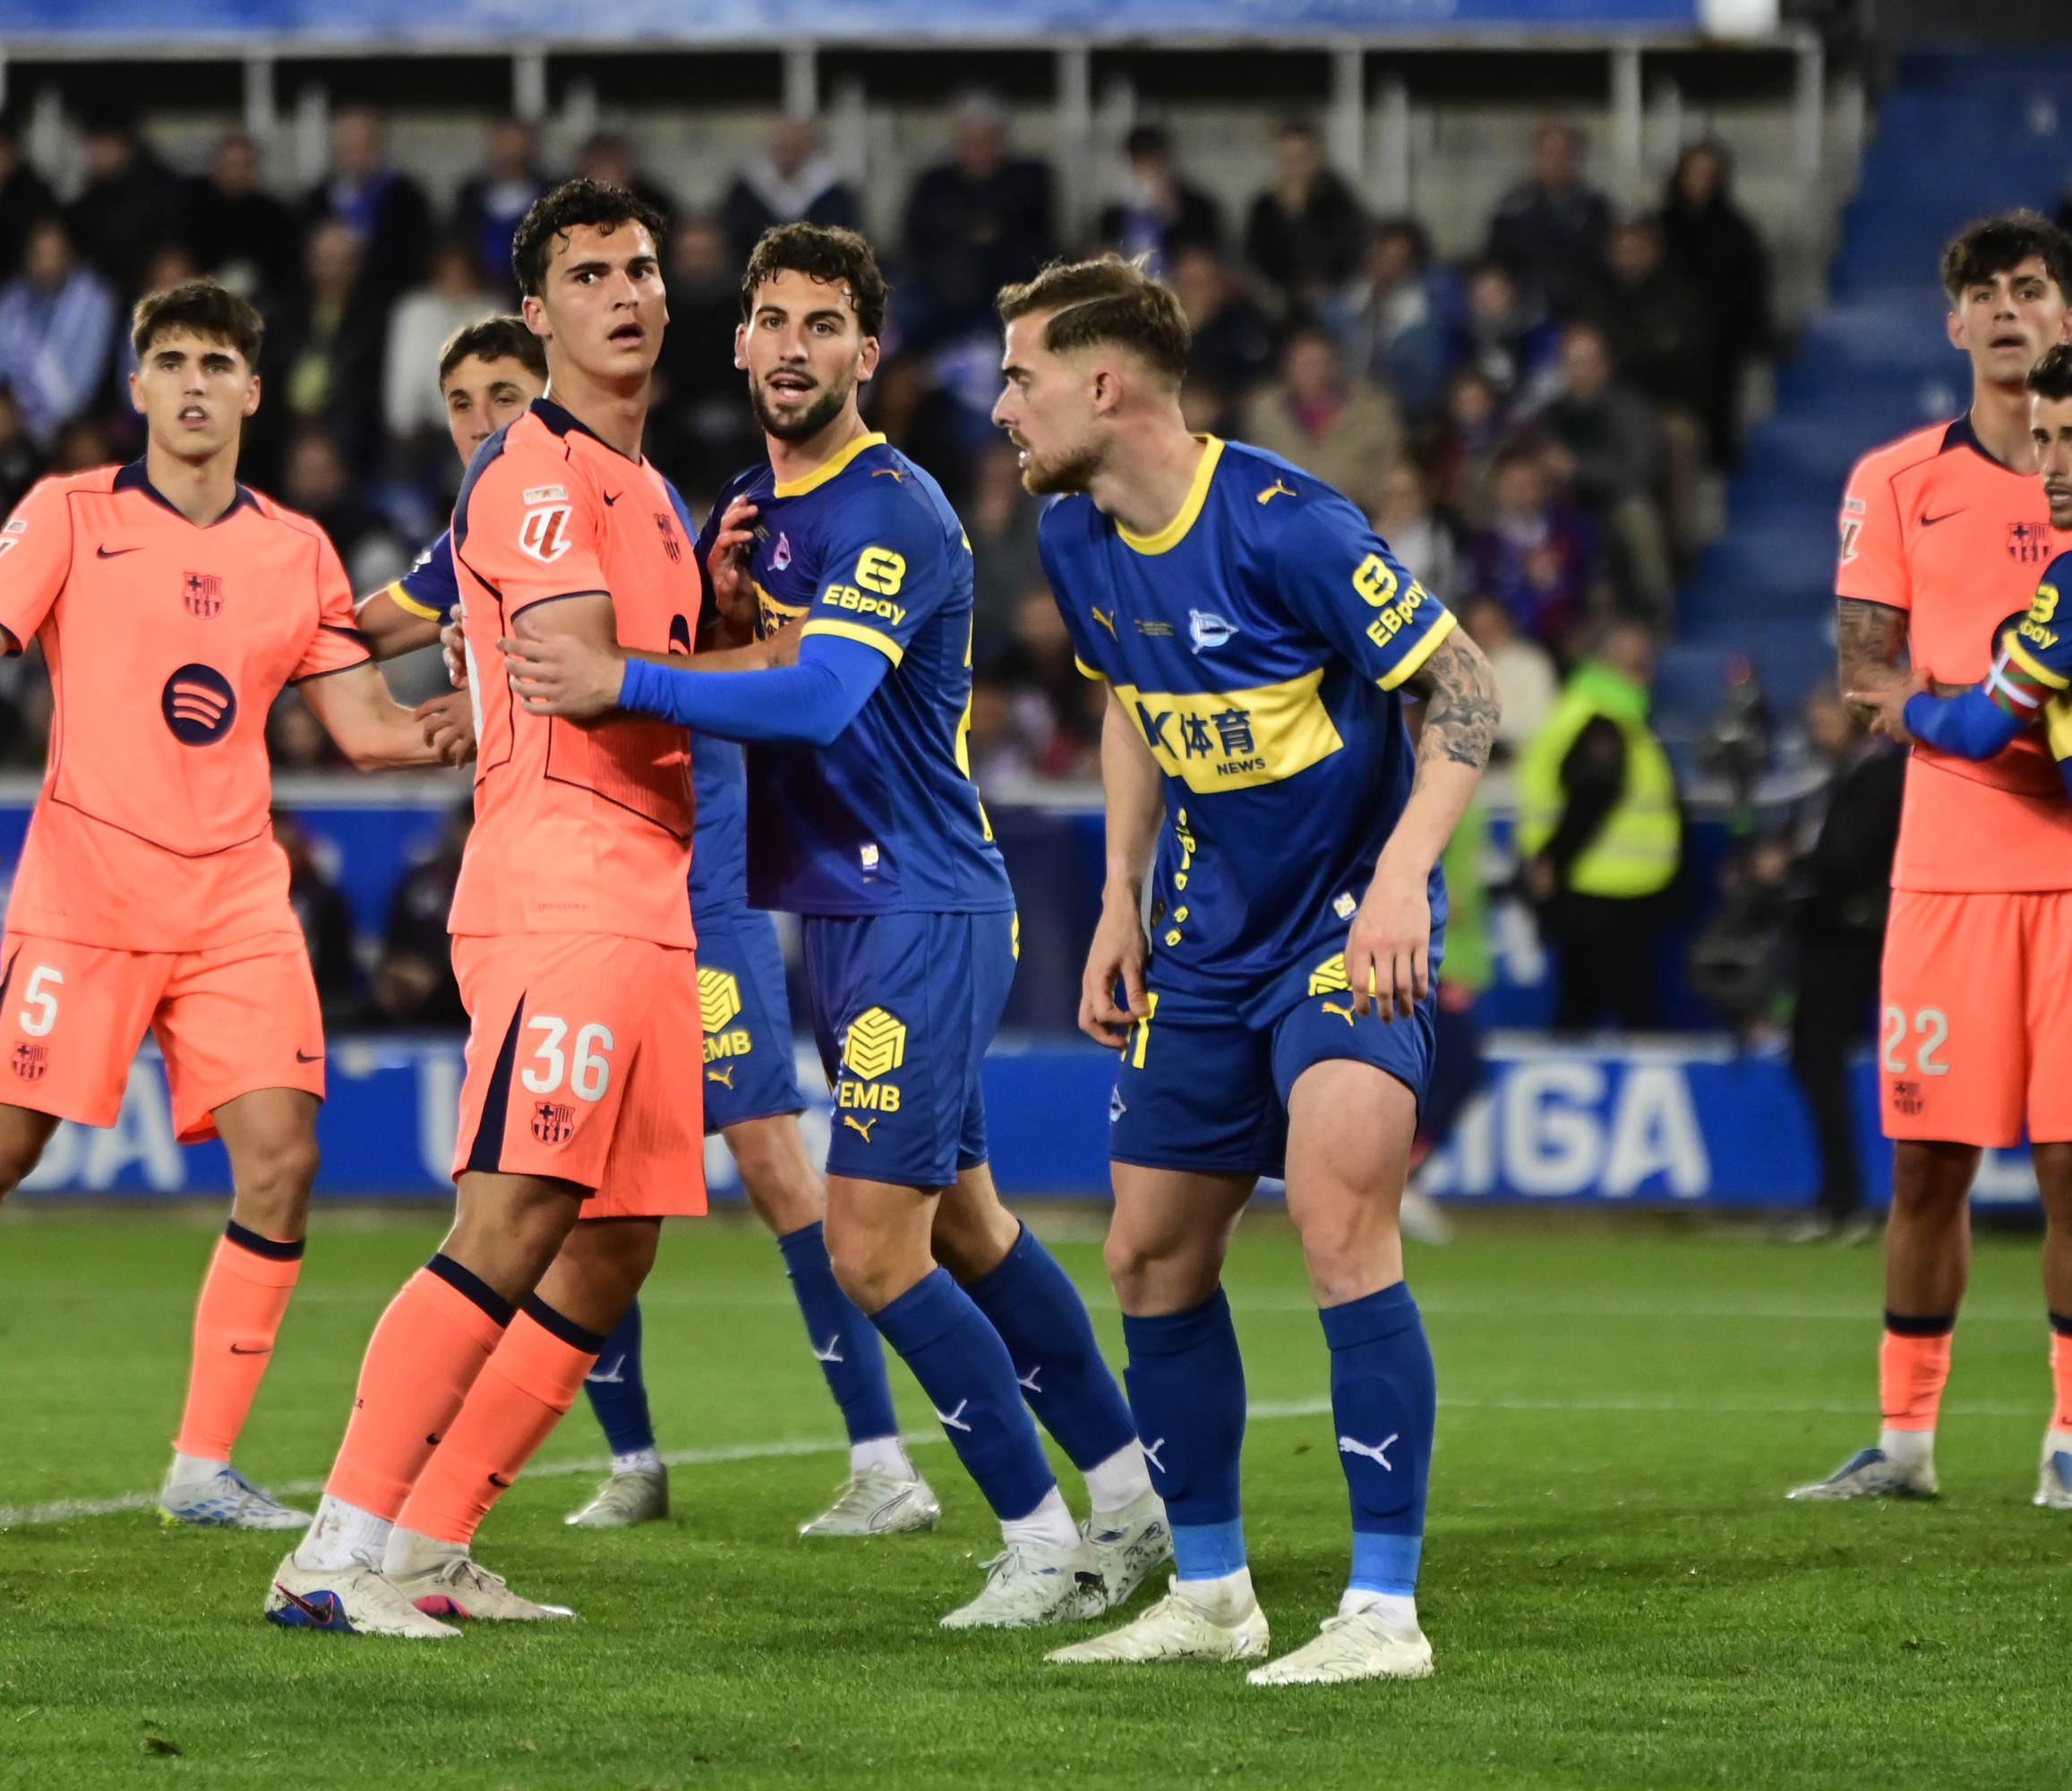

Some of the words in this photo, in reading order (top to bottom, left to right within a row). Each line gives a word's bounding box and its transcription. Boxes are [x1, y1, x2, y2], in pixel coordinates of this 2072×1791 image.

[822, 584, 906, 626] EBpay
[1366, 578, 1429, 648] EBpay
[2019, 619, 2059, 650] pay
[1216, 758, 1266, 776] NEWS
[21, 965, 64, 1037] 5
[521, 1015, 614, 1102] 36
[1884, 1006, 1950, 1076] 22
[839, 1081, 901, 1112] EMB
